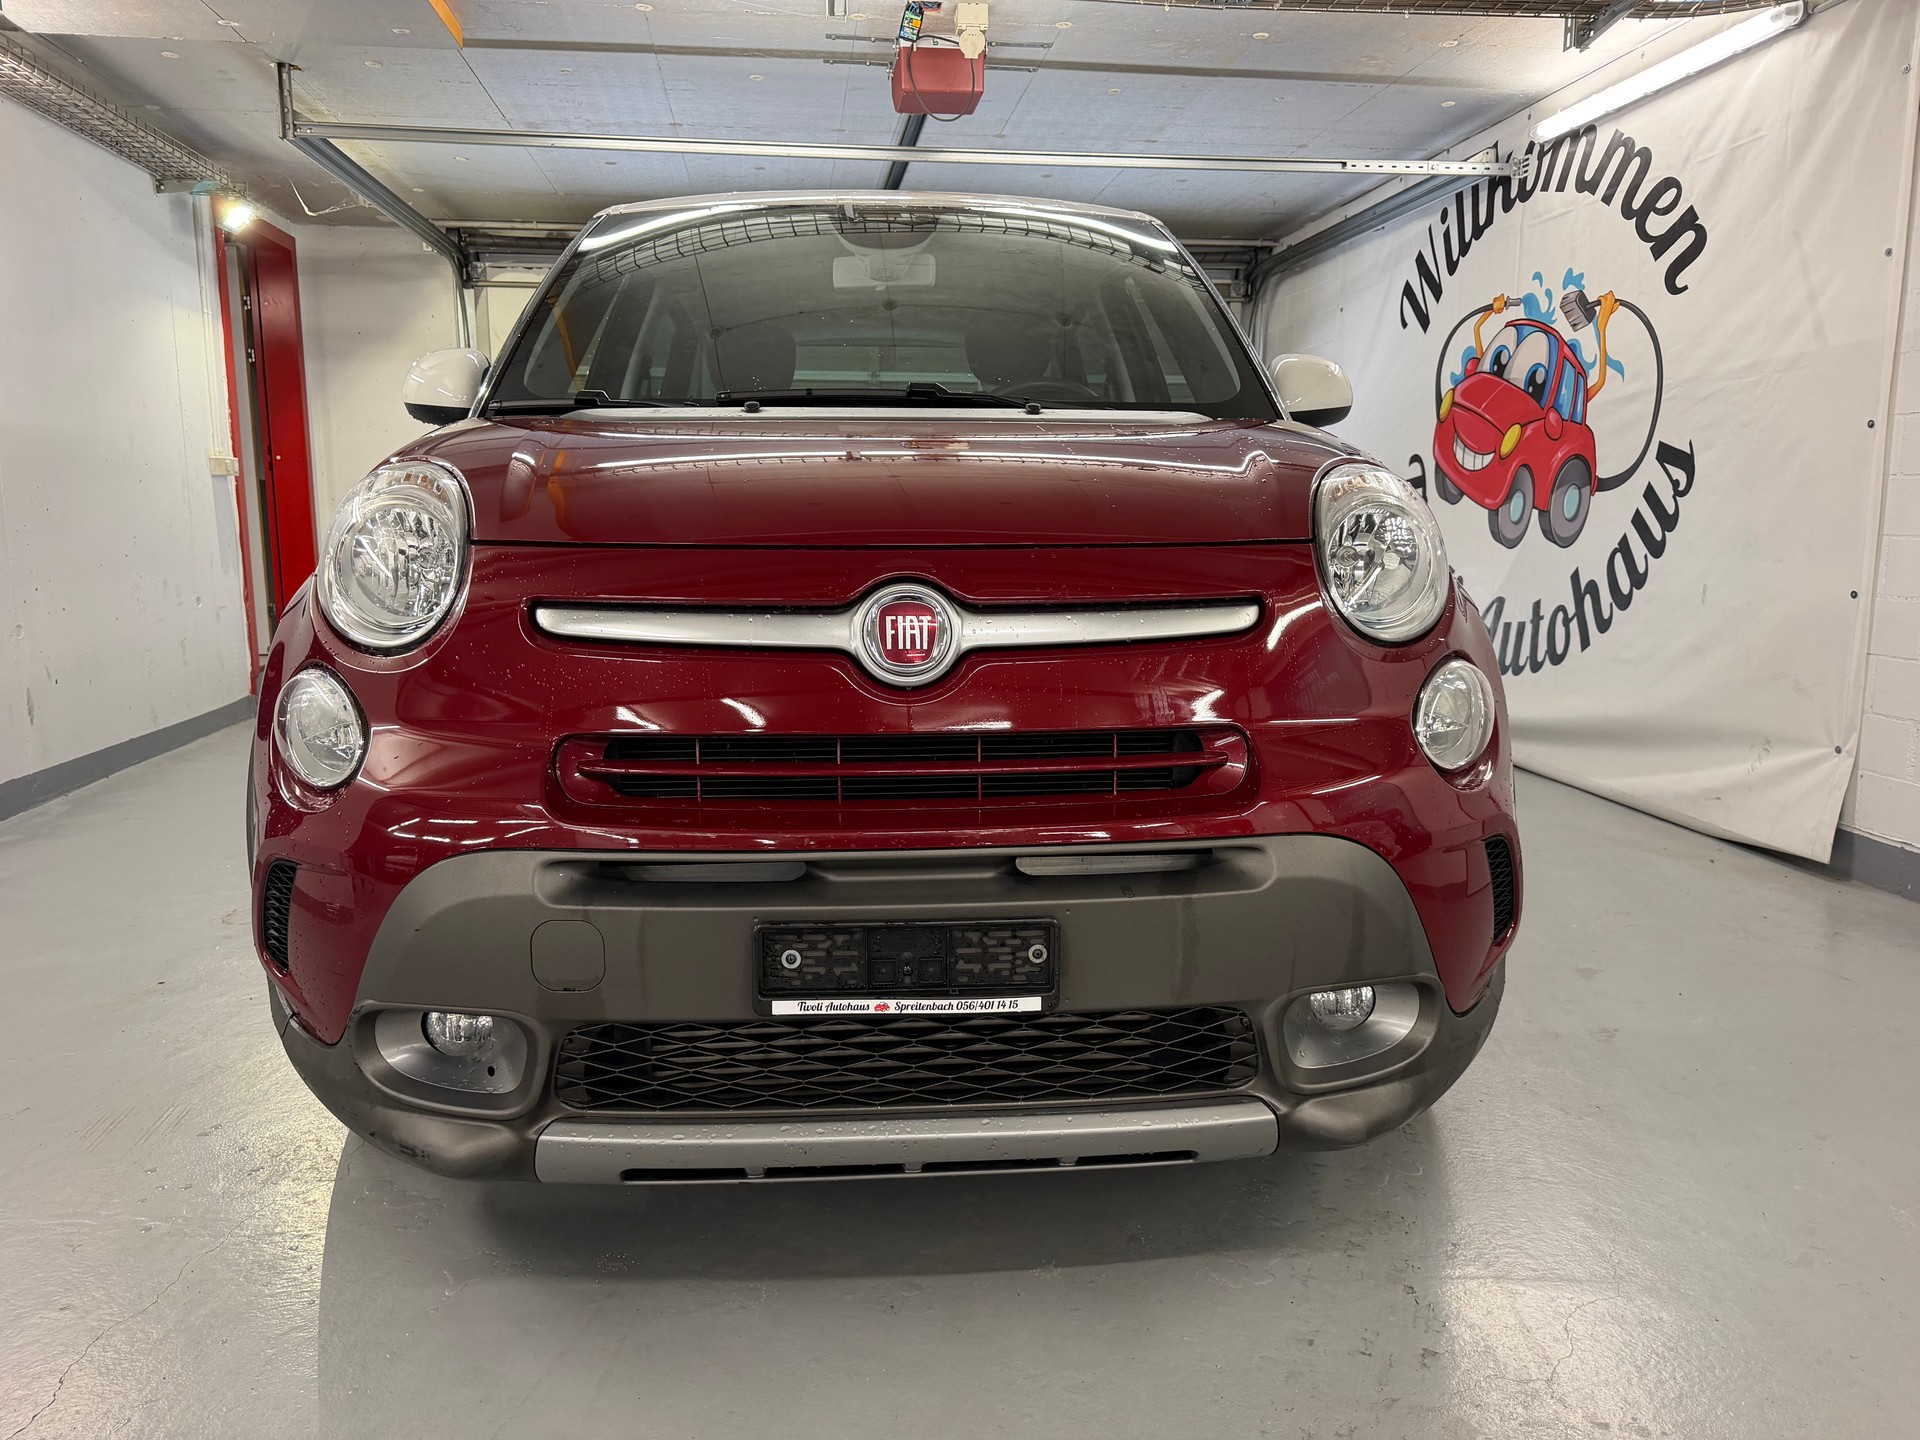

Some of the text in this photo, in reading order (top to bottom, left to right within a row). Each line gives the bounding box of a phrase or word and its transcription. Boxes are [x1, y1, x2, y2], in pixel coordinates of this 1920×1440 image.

[885, 615, 932, 650] FIAT
[797, 1000, 1018, 1013] Tivoli Autohaus Spreitenbach 056/401 14 15
